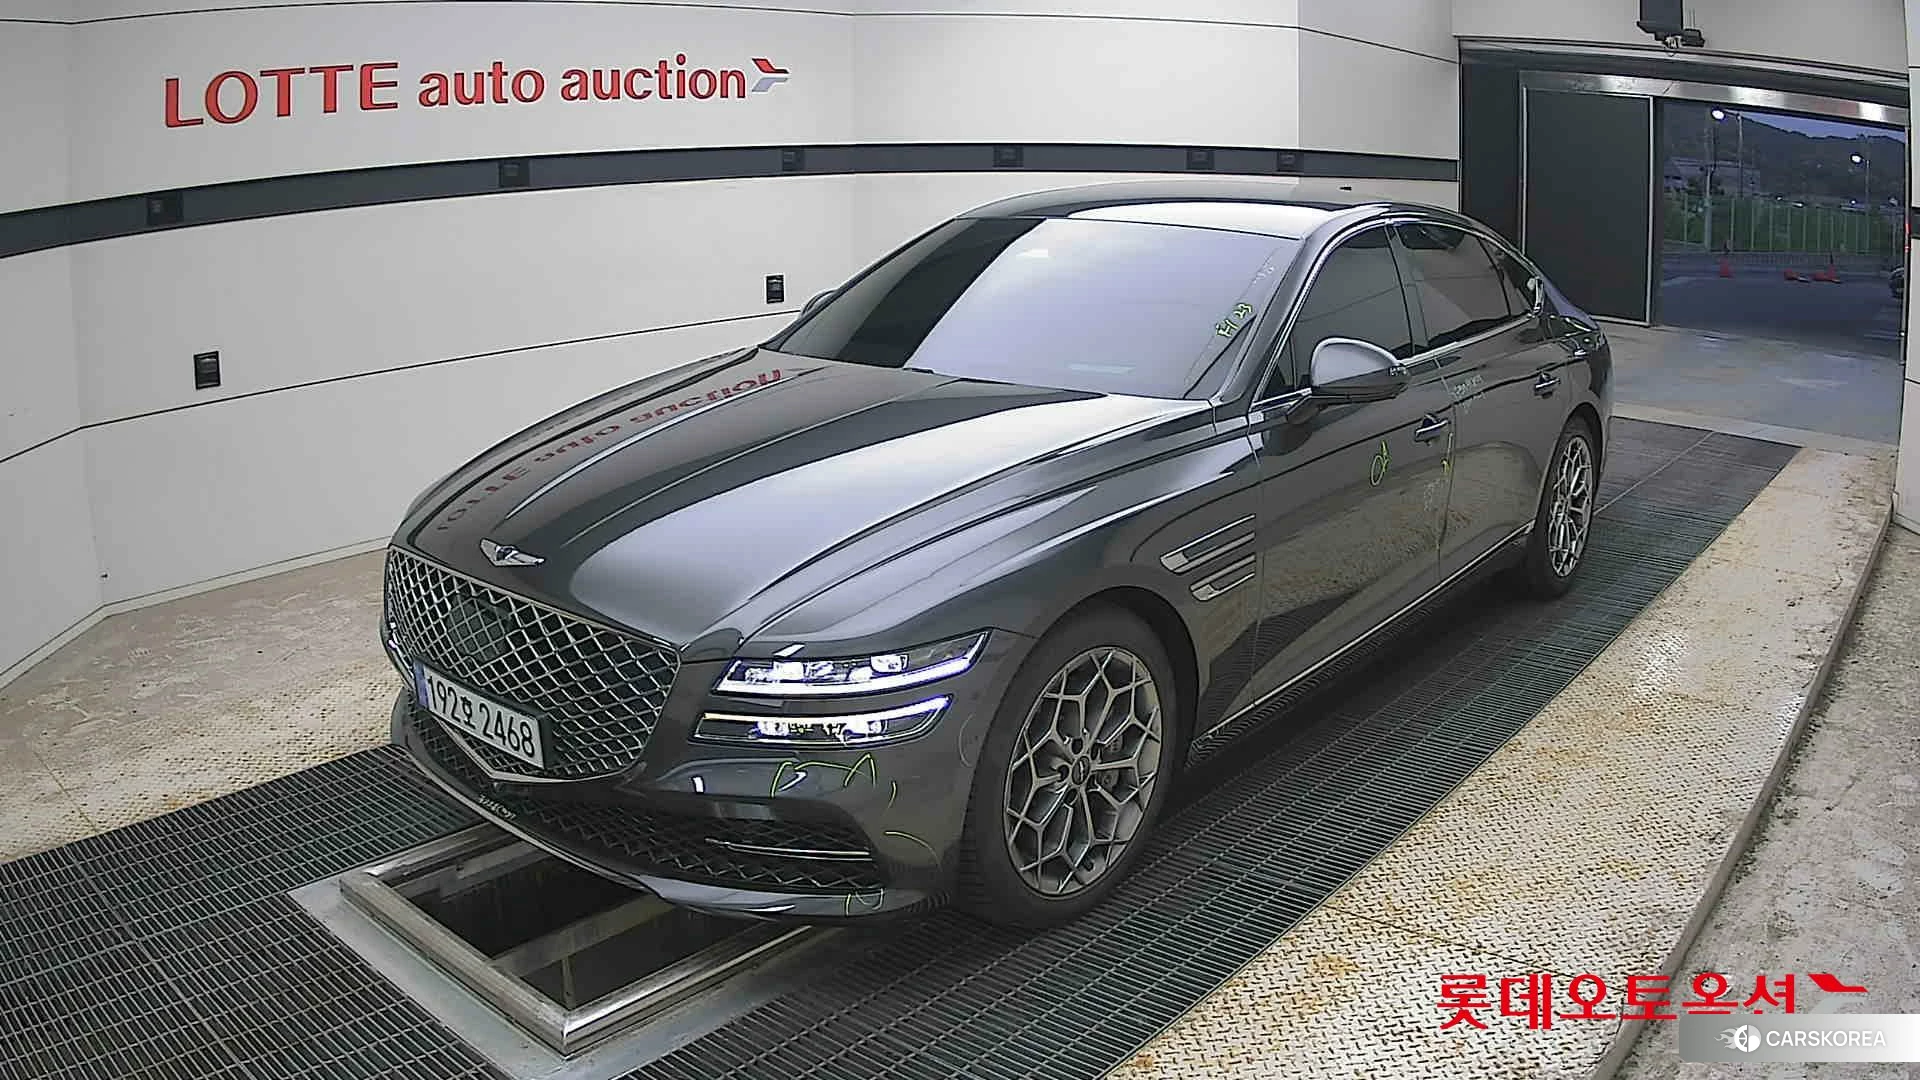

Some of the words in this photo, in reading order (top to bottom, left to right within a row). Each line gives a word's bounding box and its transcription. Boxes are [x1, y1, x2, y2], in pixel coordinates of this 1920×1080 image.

[164, 62, 398, 127] LOTTE
[418, 62, 544, 106] auto
[560, 53, 747, 101] auction
[479, 702, 535, 758] 2468
